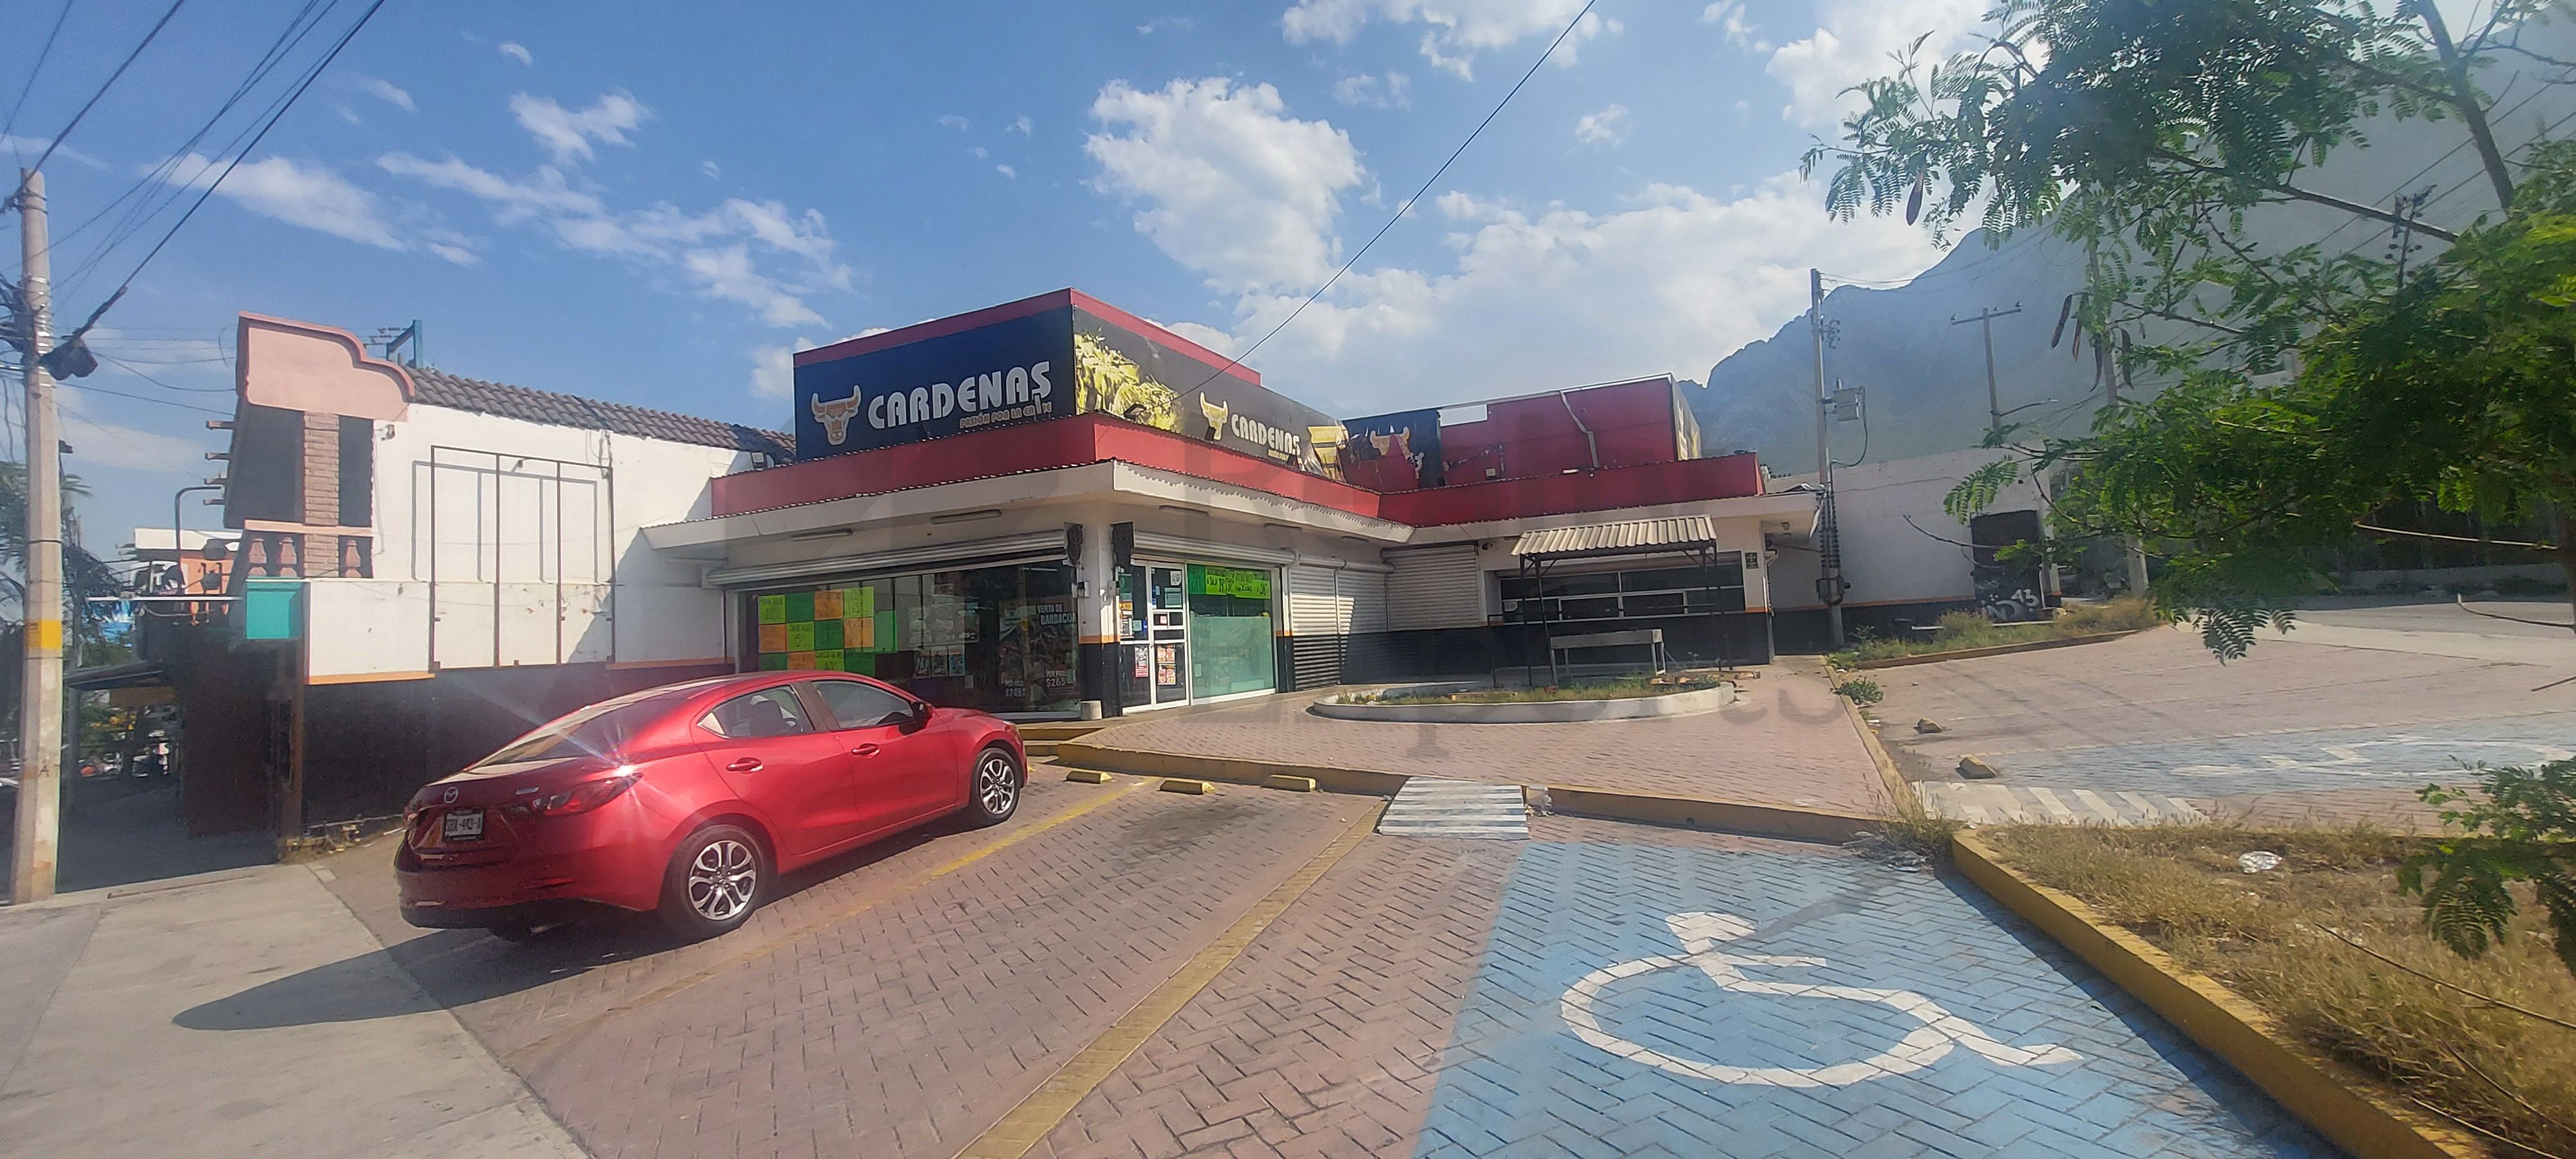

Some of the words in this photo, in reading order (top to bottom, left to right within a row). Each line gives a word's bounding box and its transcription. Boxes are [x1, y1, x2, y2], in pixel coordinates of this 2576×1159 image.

[867, 361, 1052, 429] CARDENAS
[960, 413, 990, 429] PASIÓN
[991, 410, 1010, 422] POR
[1011, 407, 1023, 419] LA
[1231, 413, 1301, 456] CARDENAS
[1037, 605, 1054, 613] VENTA
[1056, 604, 1063, 612] DE
[1040, 612, 1077, 626] BARBACOA
[1046, 677, 1066, 688] $265
